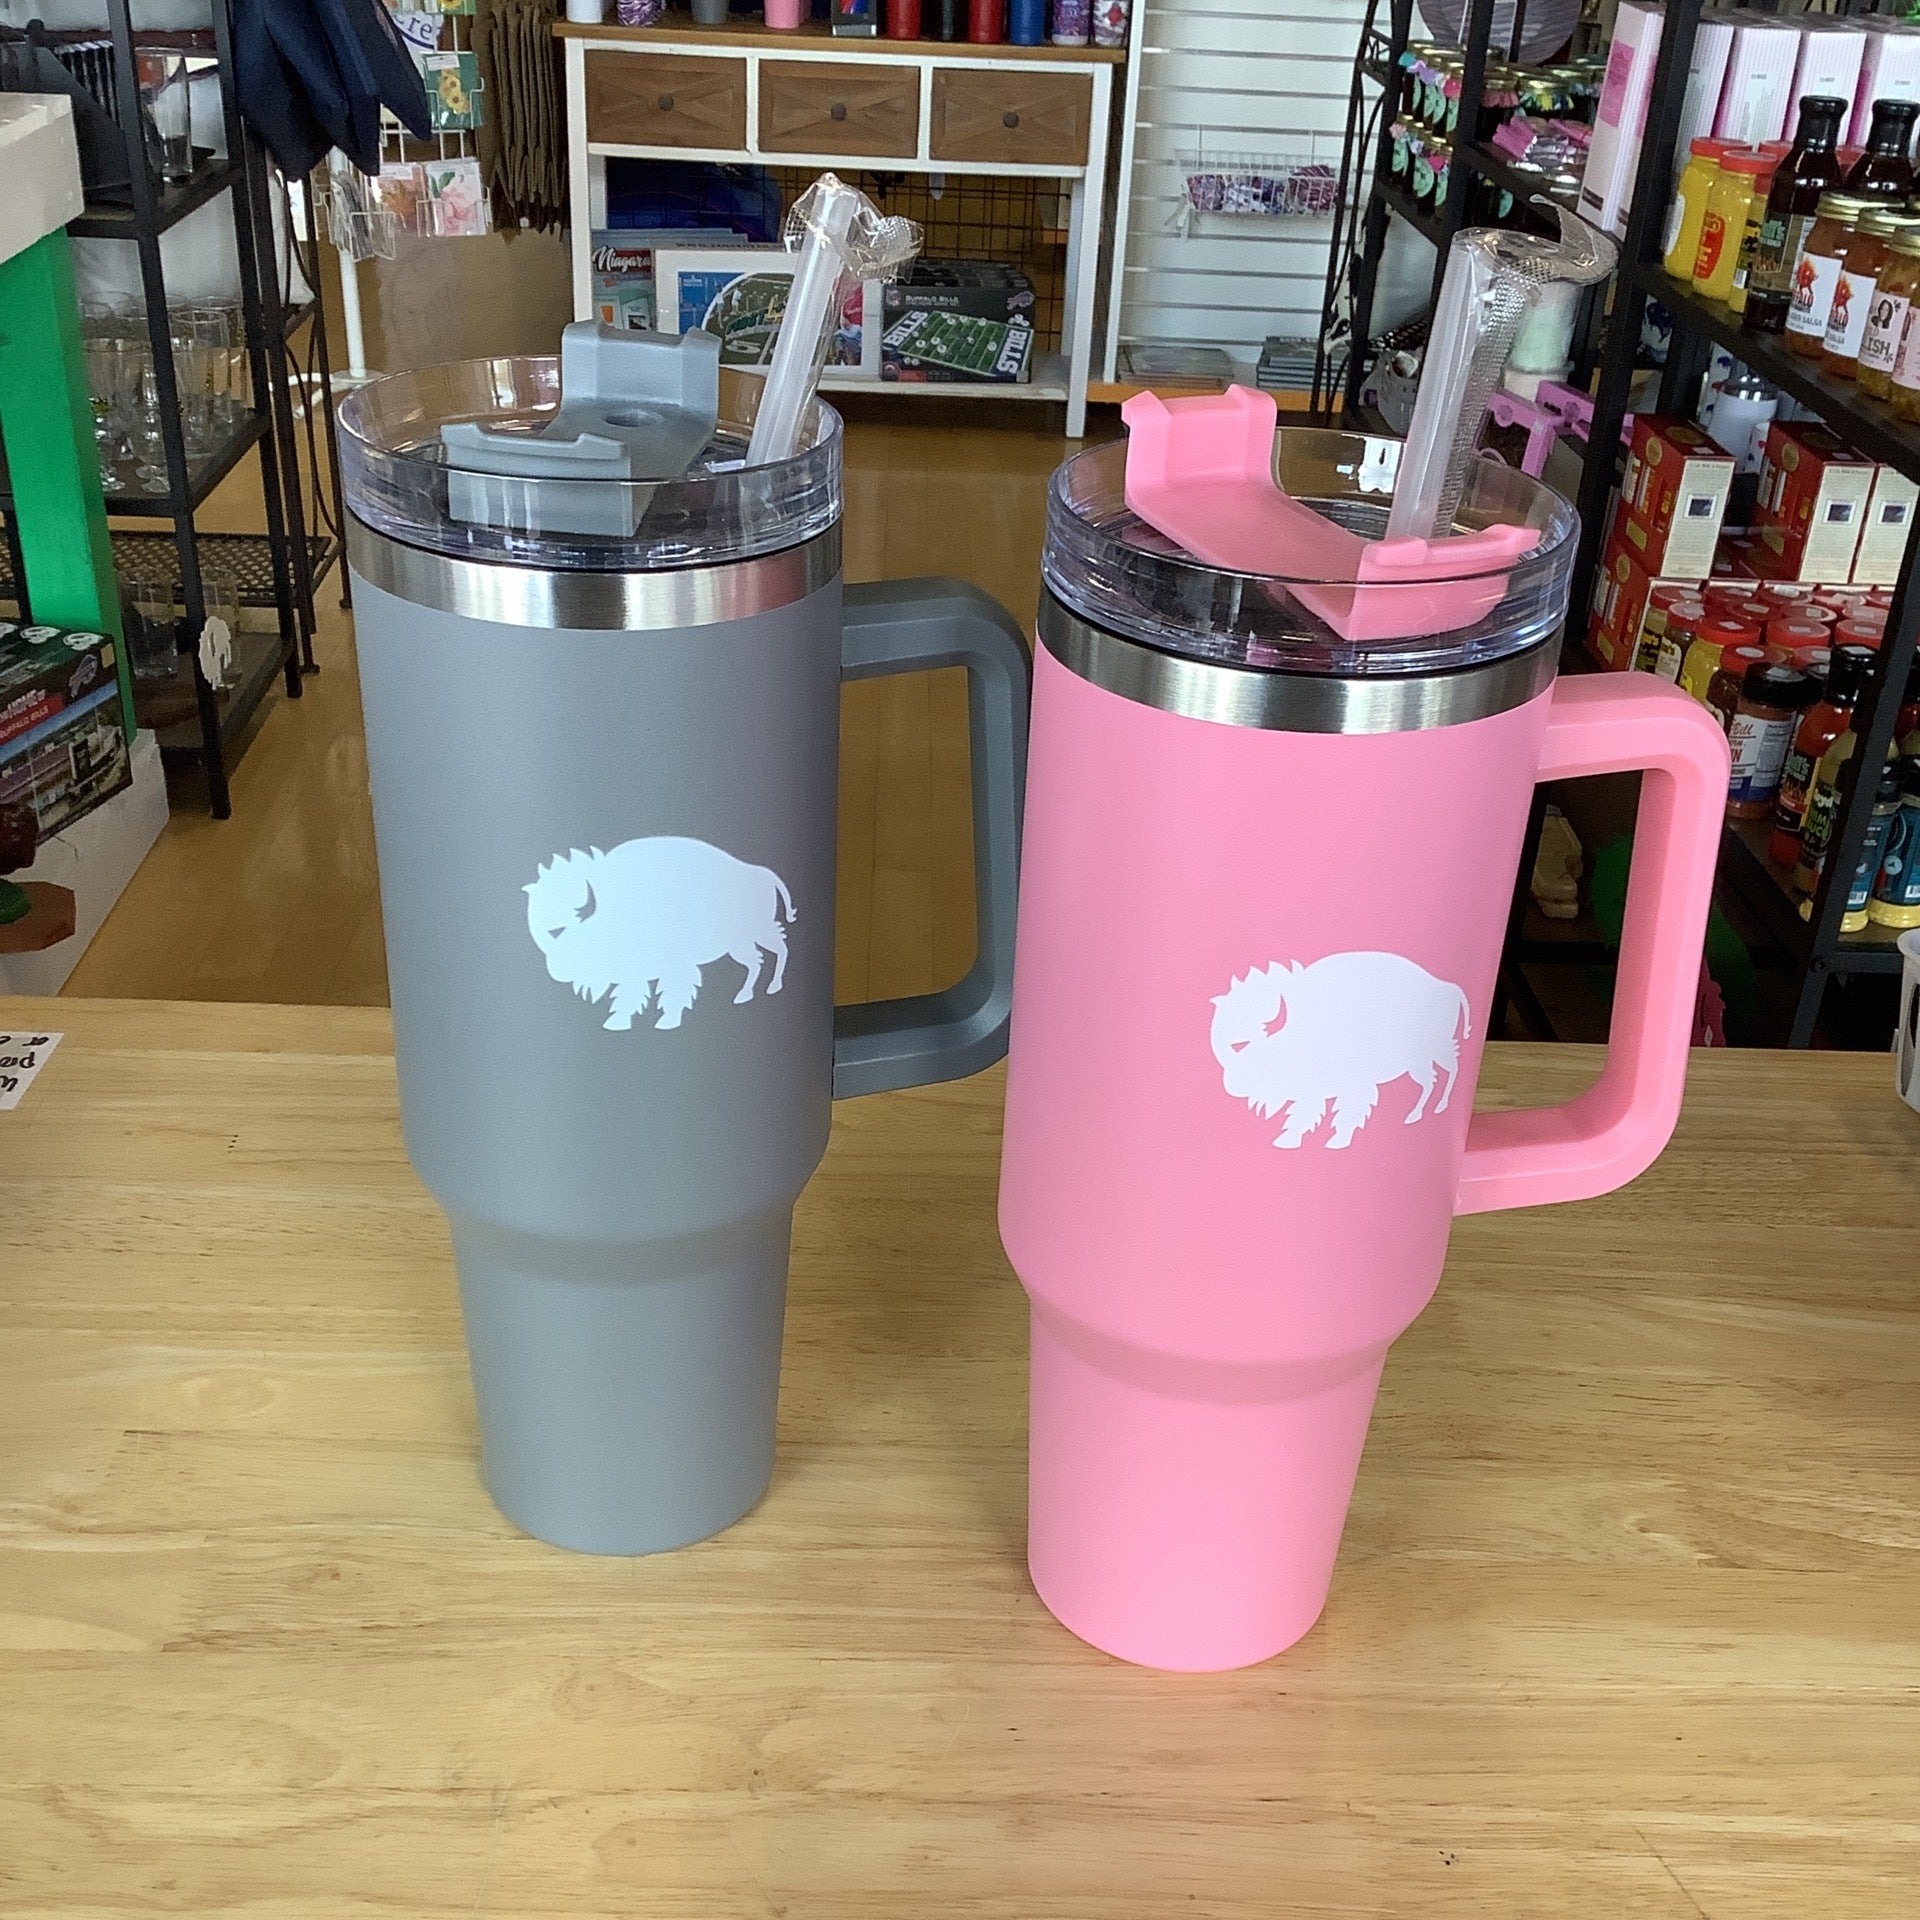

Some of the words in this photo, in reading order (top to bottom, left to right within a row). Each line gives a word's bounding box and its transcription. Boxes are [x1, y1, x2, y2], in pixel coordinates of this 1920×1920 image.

[592, 245, 652, 273] Niagara
[882, 311, 928, 347] BILLS
[996, 329, 1028, 375] BILLS
